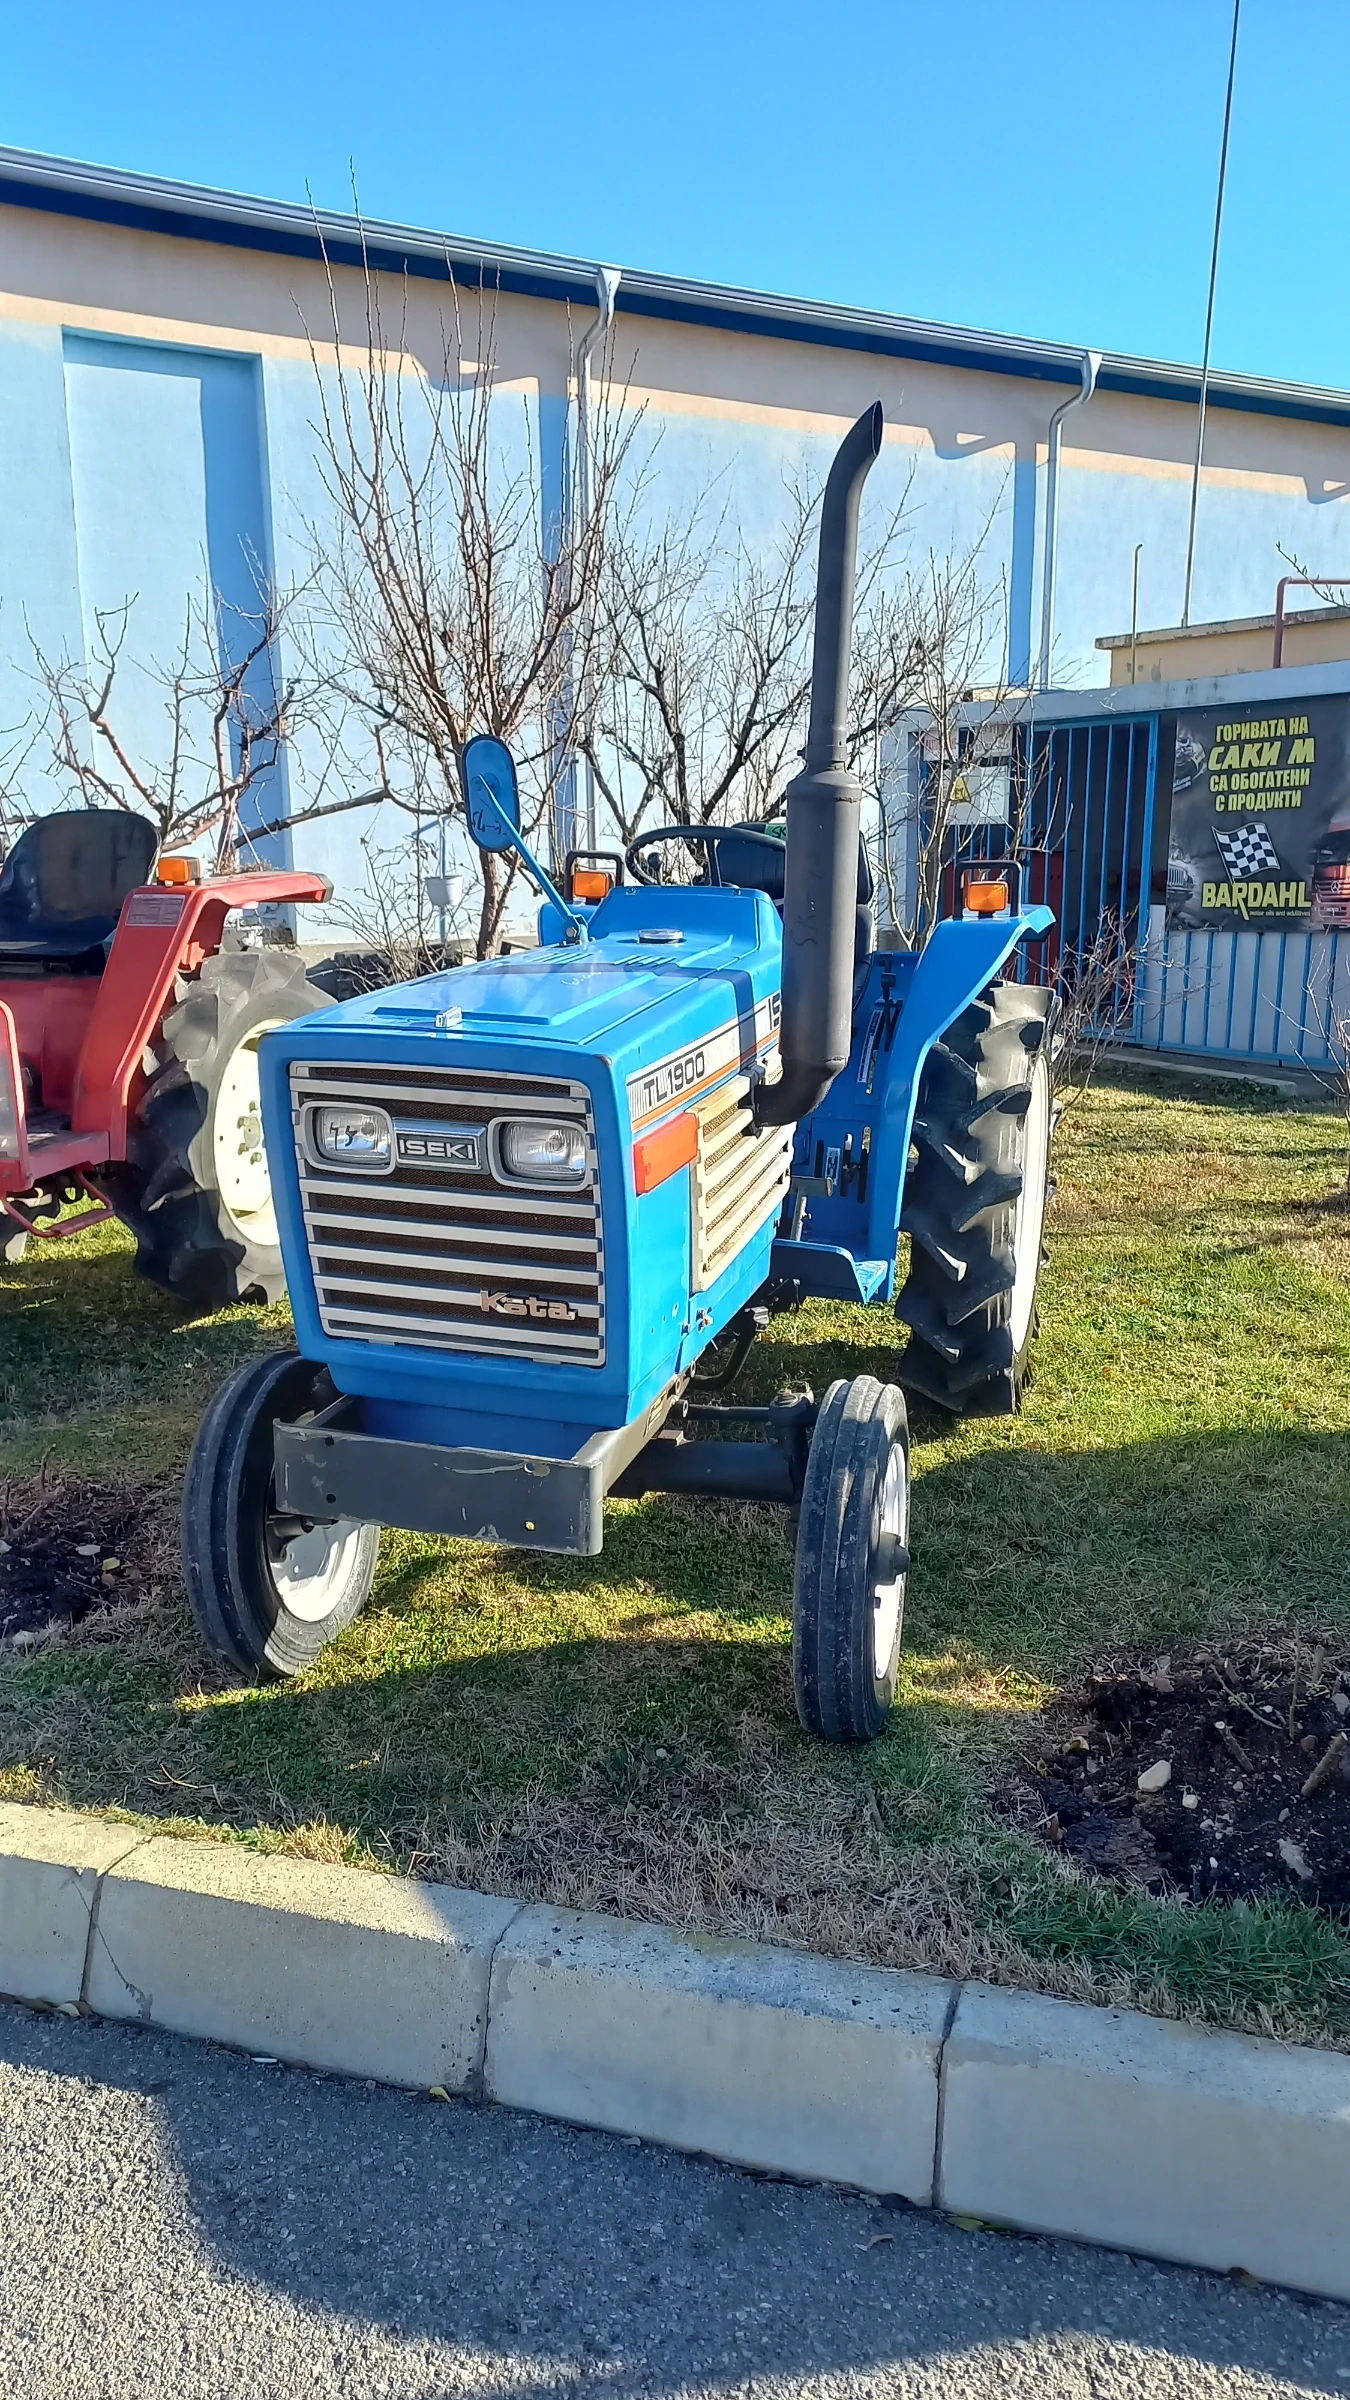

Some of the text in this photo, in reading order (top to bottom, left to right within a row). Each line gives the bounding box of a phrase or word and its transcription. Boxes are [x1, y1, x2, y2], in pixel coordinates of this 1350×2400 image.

[1216, 716, 1309, 742] ГОРИВАТА НА
[1208, 738, 1315, 771] САКИ М
[1210, 774, 1228, 792] СА
[1231, 768, 1310, 791] ОБОГАТЕНИ
[1215, 790, 1302, 812] С ПРОДУКТИ
[1202, 881, 1312, 920] BARDAHL
[643, 1051, 705, 1107] TL1900
[399, 1139, 474, 1160] ISEKI
